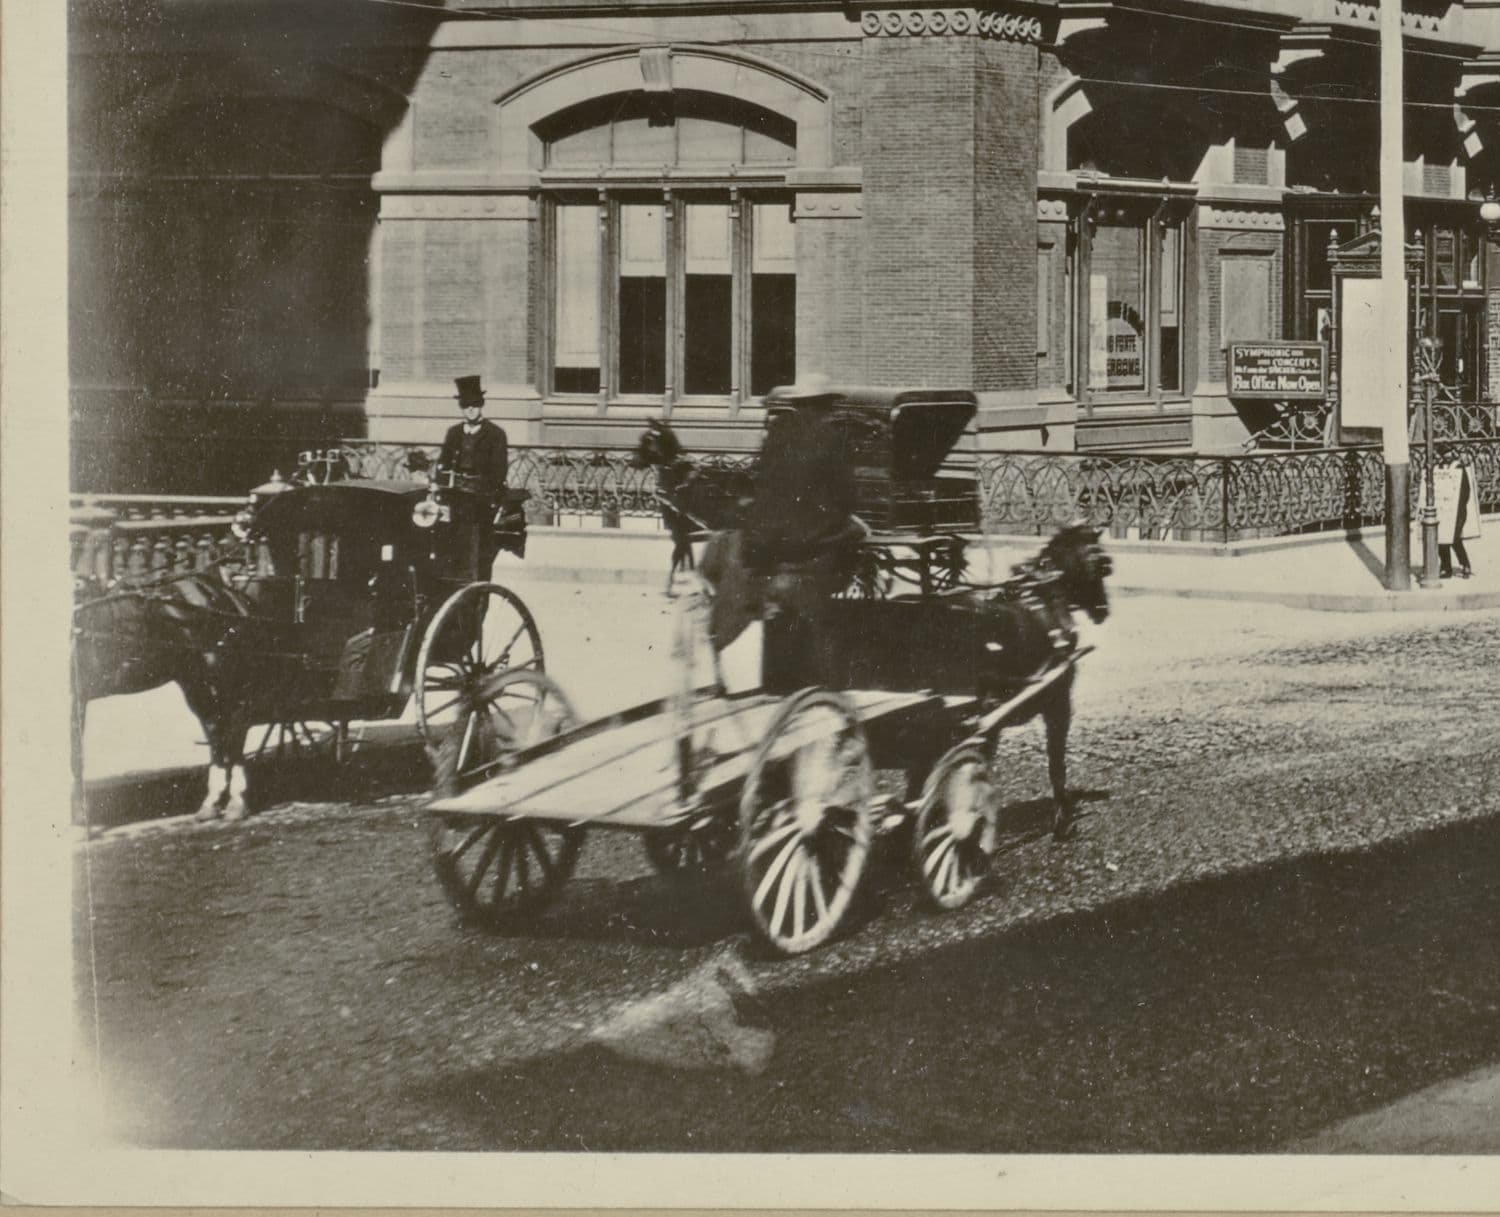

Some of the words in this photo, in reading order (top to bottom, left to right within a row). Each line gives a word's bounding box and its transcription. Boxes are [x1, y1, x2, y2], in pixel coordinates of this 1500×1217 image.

[1236, 348, 1291, 359] SYMPHONIC
[1251, 376, 1276, 389] Office
[1277, 376, 1299, 389] Now
